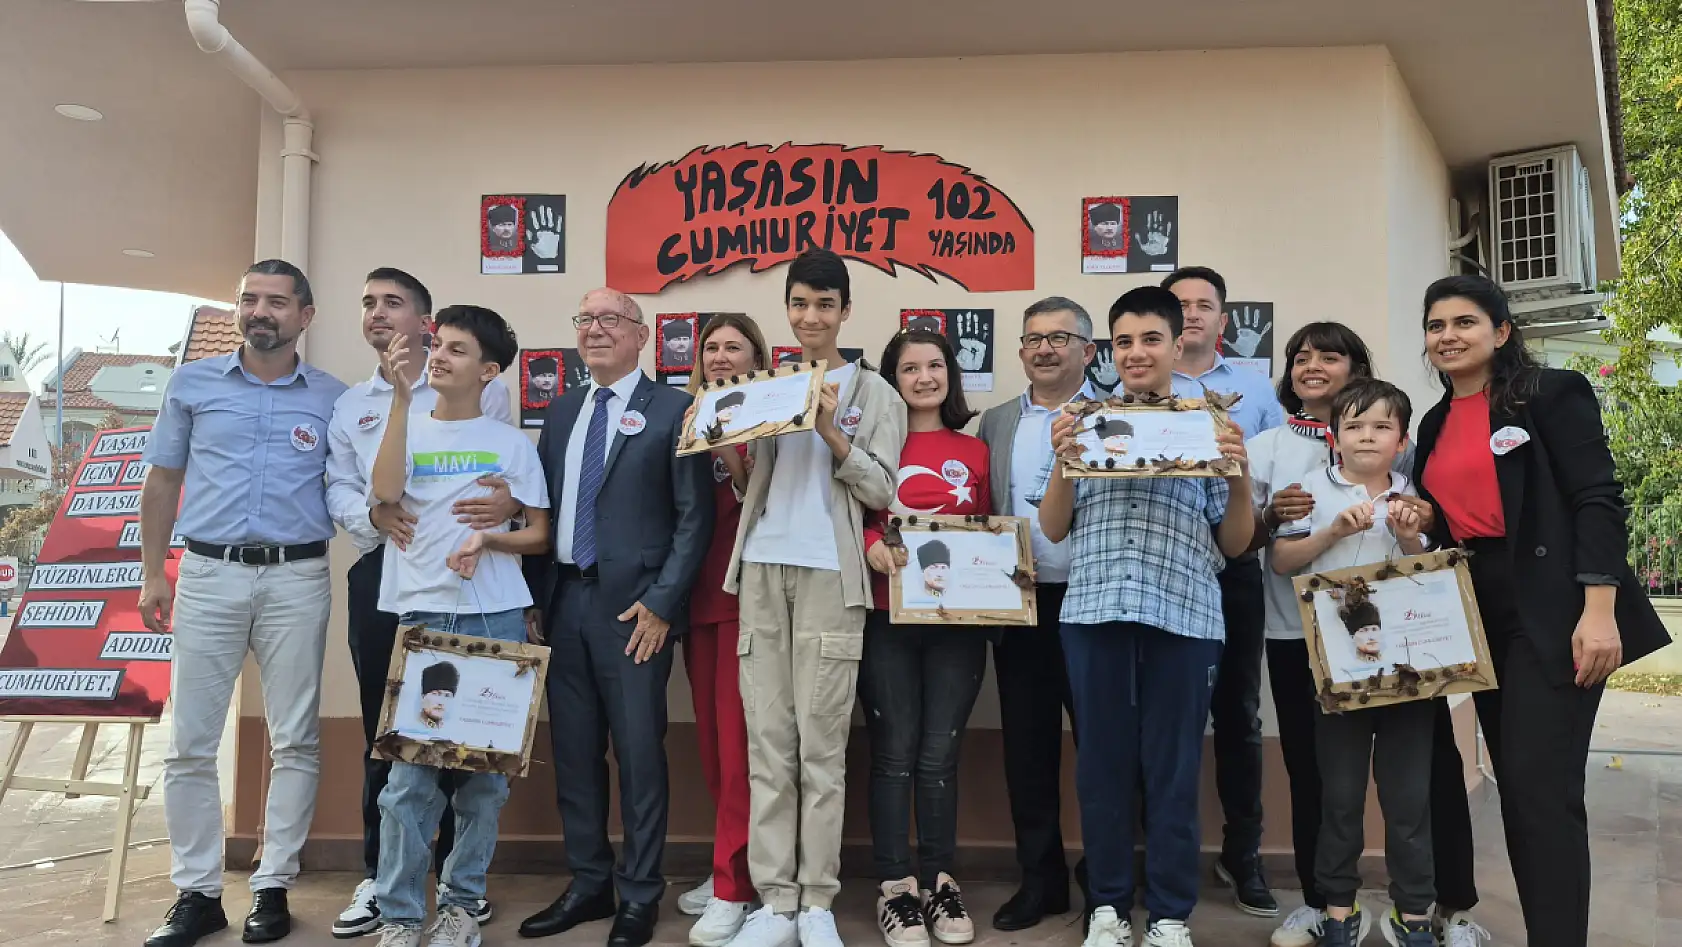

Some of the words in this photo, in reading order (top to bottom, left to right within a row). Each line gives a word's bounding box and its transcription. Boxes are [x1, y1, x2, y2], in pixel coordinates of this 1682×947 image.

[674, 157, 878, 222] YAŞASIN
[927, 178, 996, 220] 102
[656, 205, 910, 275] CUMHURİYET
[928, 229, 1016, 257] YAŞINDA
[22, 602, 98, 625] ŞEHİDİN
[104, 637, 173, 654] ADIDIR
